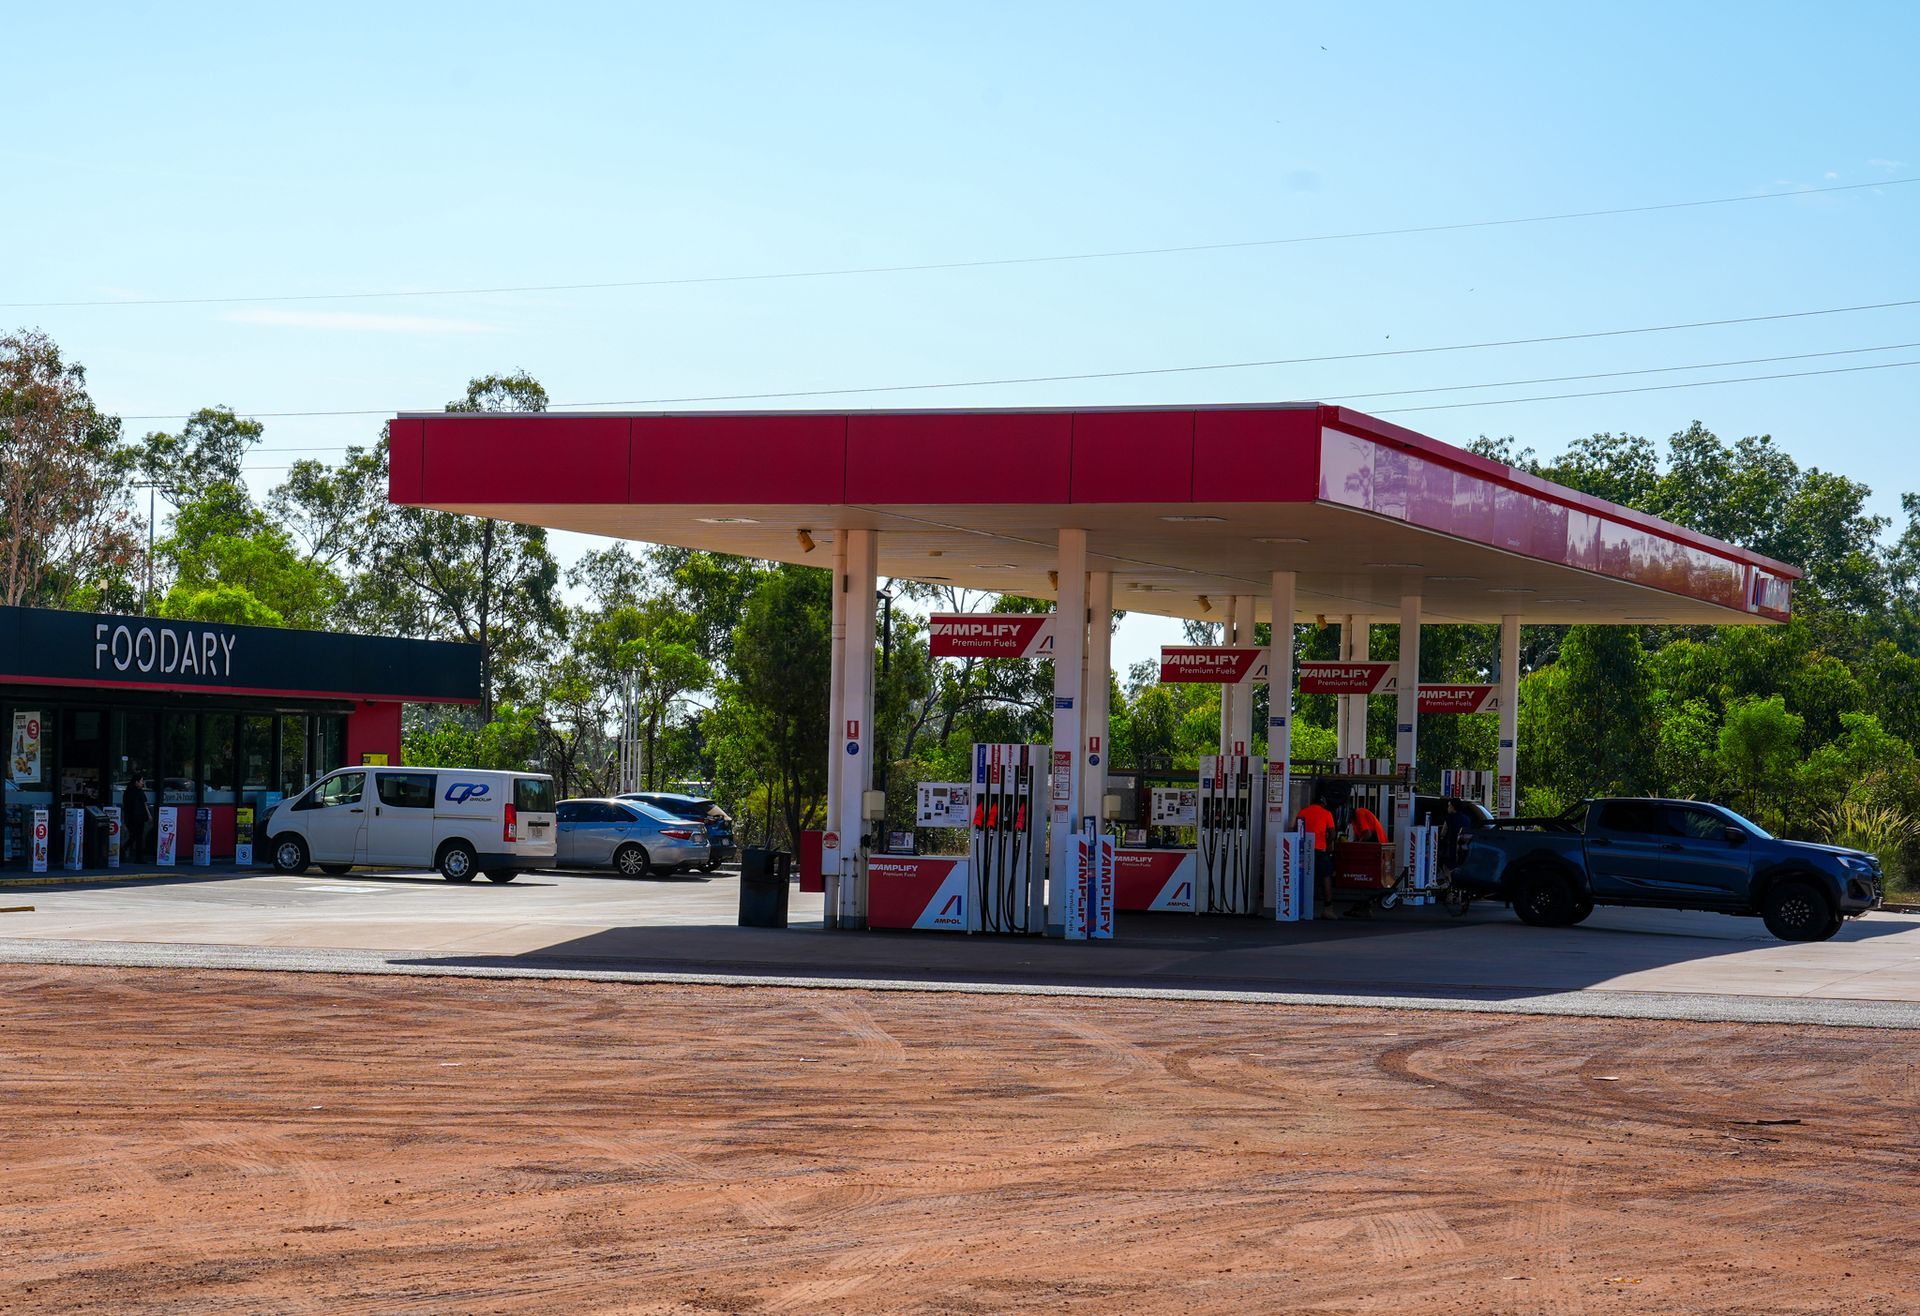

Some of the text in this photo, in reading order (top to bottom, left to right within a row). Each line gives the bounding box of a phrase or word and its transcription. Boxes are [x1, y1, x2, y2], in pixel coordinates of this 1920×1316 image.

[937, 623, 1021, 637] AMPLIFY
[952, 638, 1017, 648] Premium Fuels
[96, 624, 236, 677] FOODARY
[1168, 655, 1240, 666] AMPLIFY
[1179, 667, 1236, 675] Premium Fuels
[1308, 669, 1372, 679] AMPLIFY
[1418, 690, 1475, 699] AMPLIFY
[876, 863, 919, 872] AMPLIFY
[1100, 853, 1112, 934] AMPLIFY
